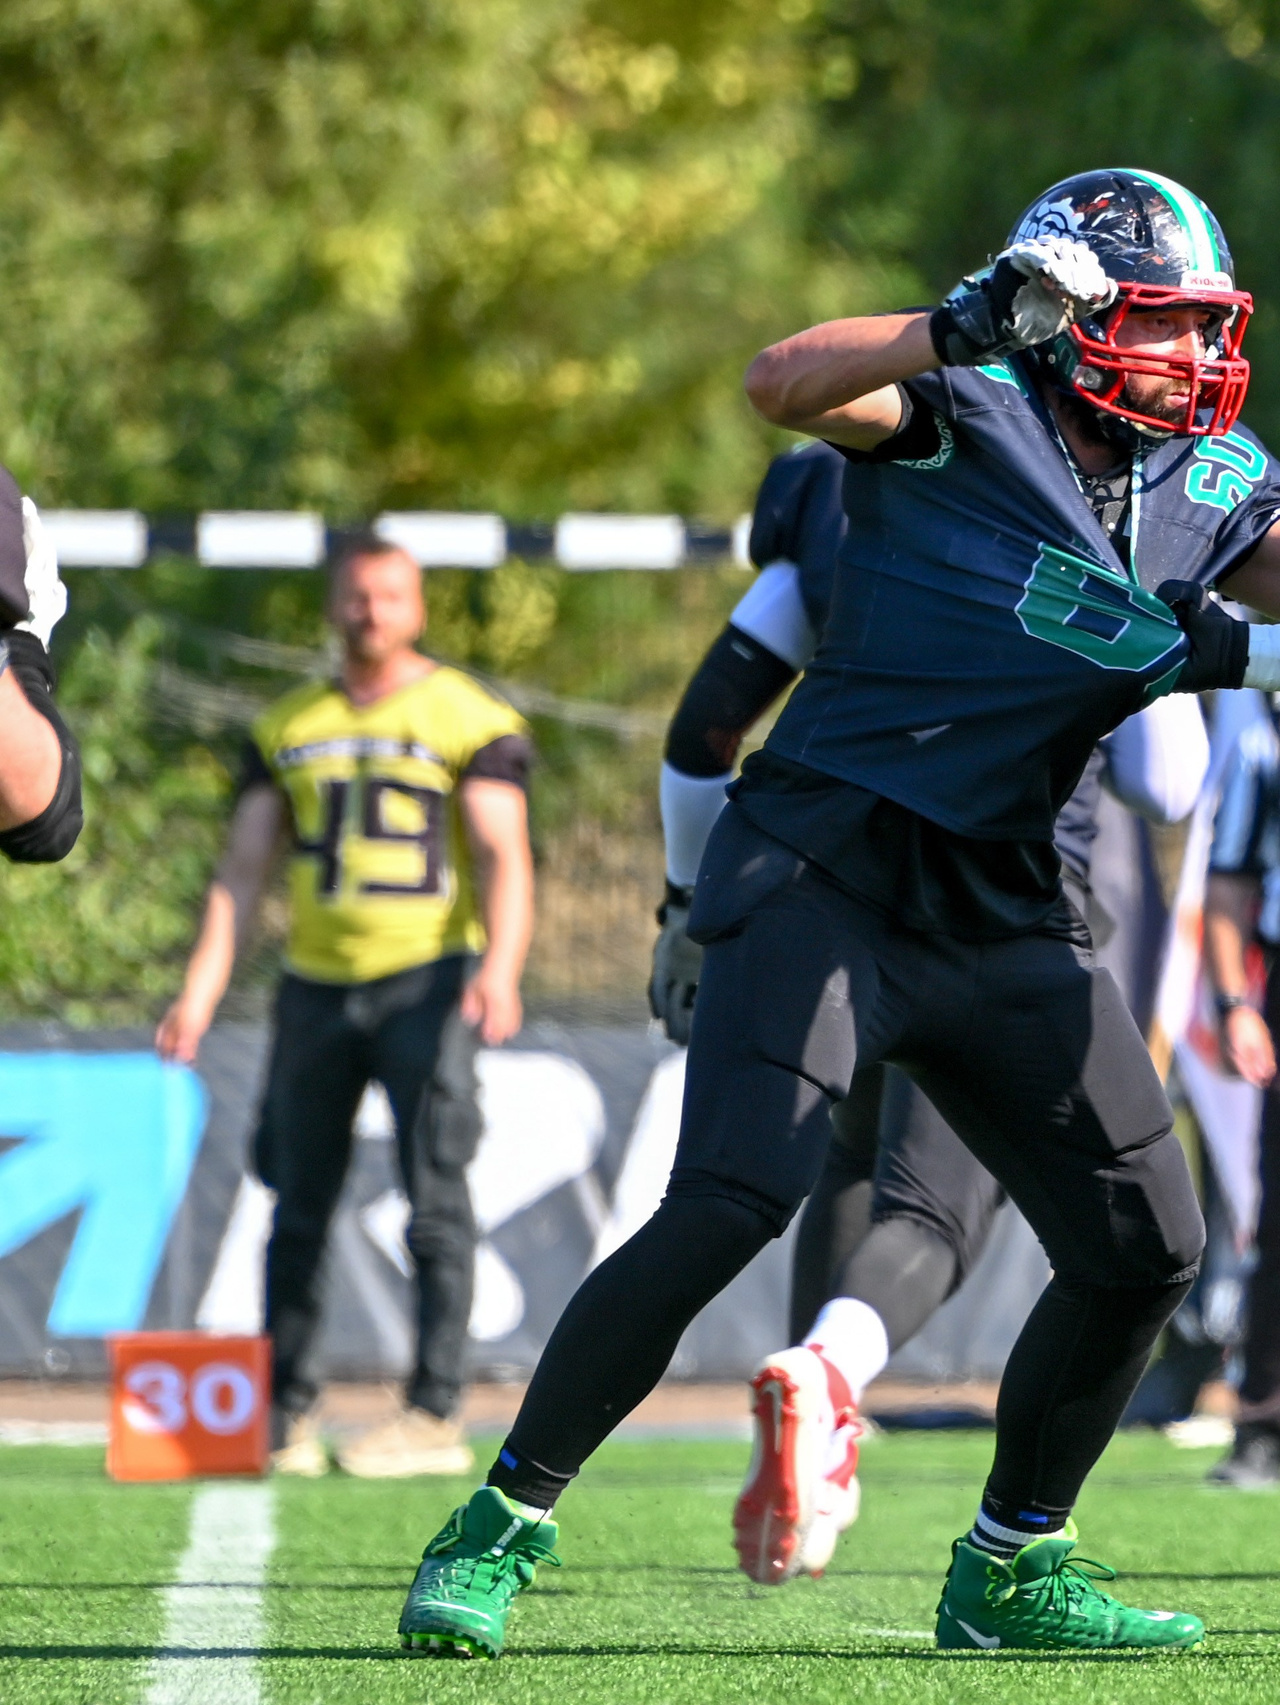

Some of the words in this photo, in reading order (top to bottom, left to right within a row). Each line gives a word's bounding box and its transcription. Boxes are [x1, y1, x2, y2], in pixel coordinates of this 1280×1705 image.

[1014, 541, 1190, 708] 6
[288, 775, 450, 898] 49
[122, 1360, 260, 1437] 30
